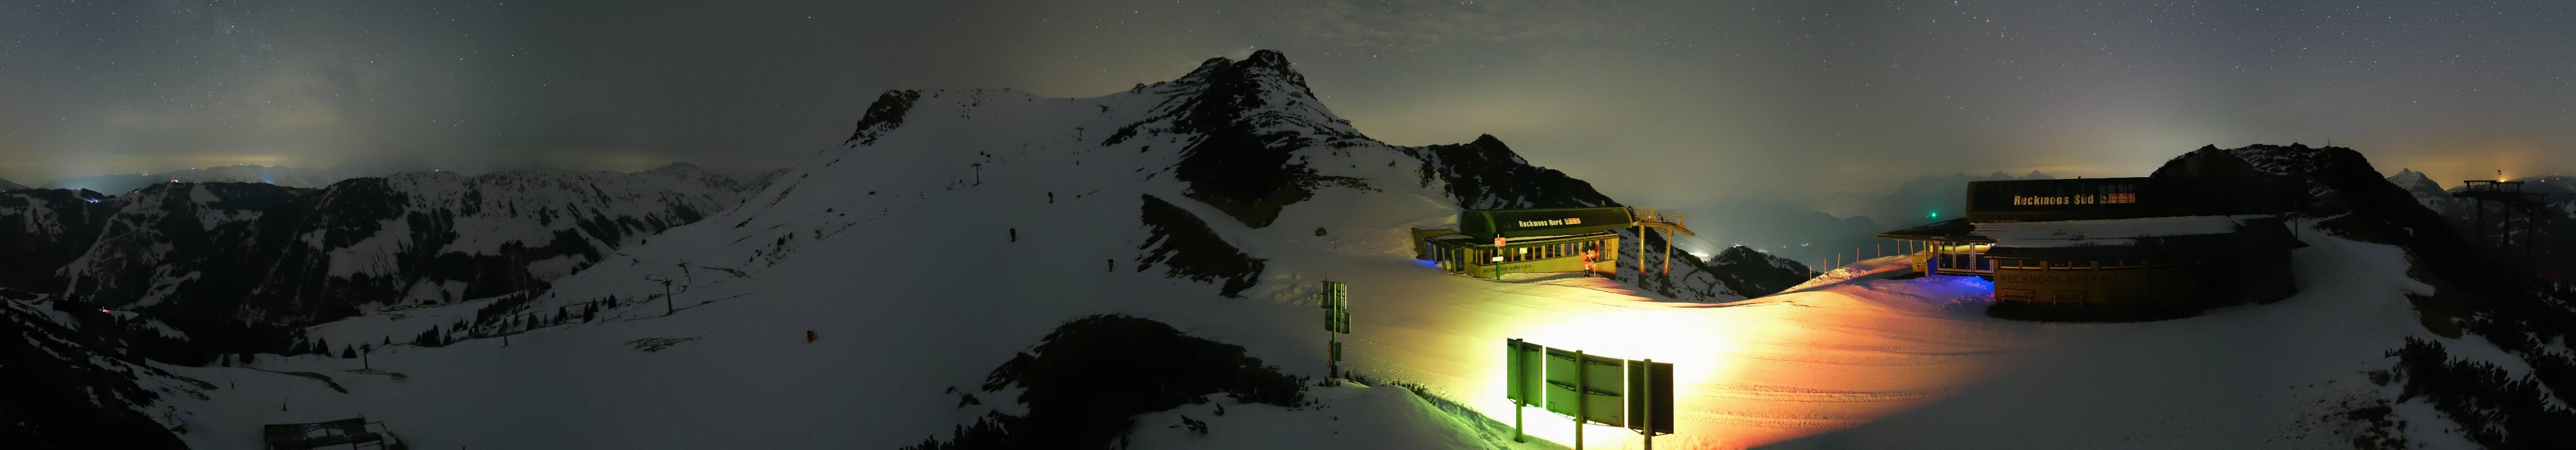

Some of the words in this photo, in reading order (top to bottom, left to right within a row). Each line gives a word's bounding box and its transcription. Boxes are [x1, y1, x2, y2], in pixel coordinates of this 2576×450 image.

[2014, 195, 2069, 205] Reckmoos
[2074, 194, 2093, 204] Süd
[1999, 274, 2062, 284] RECKMOOS
